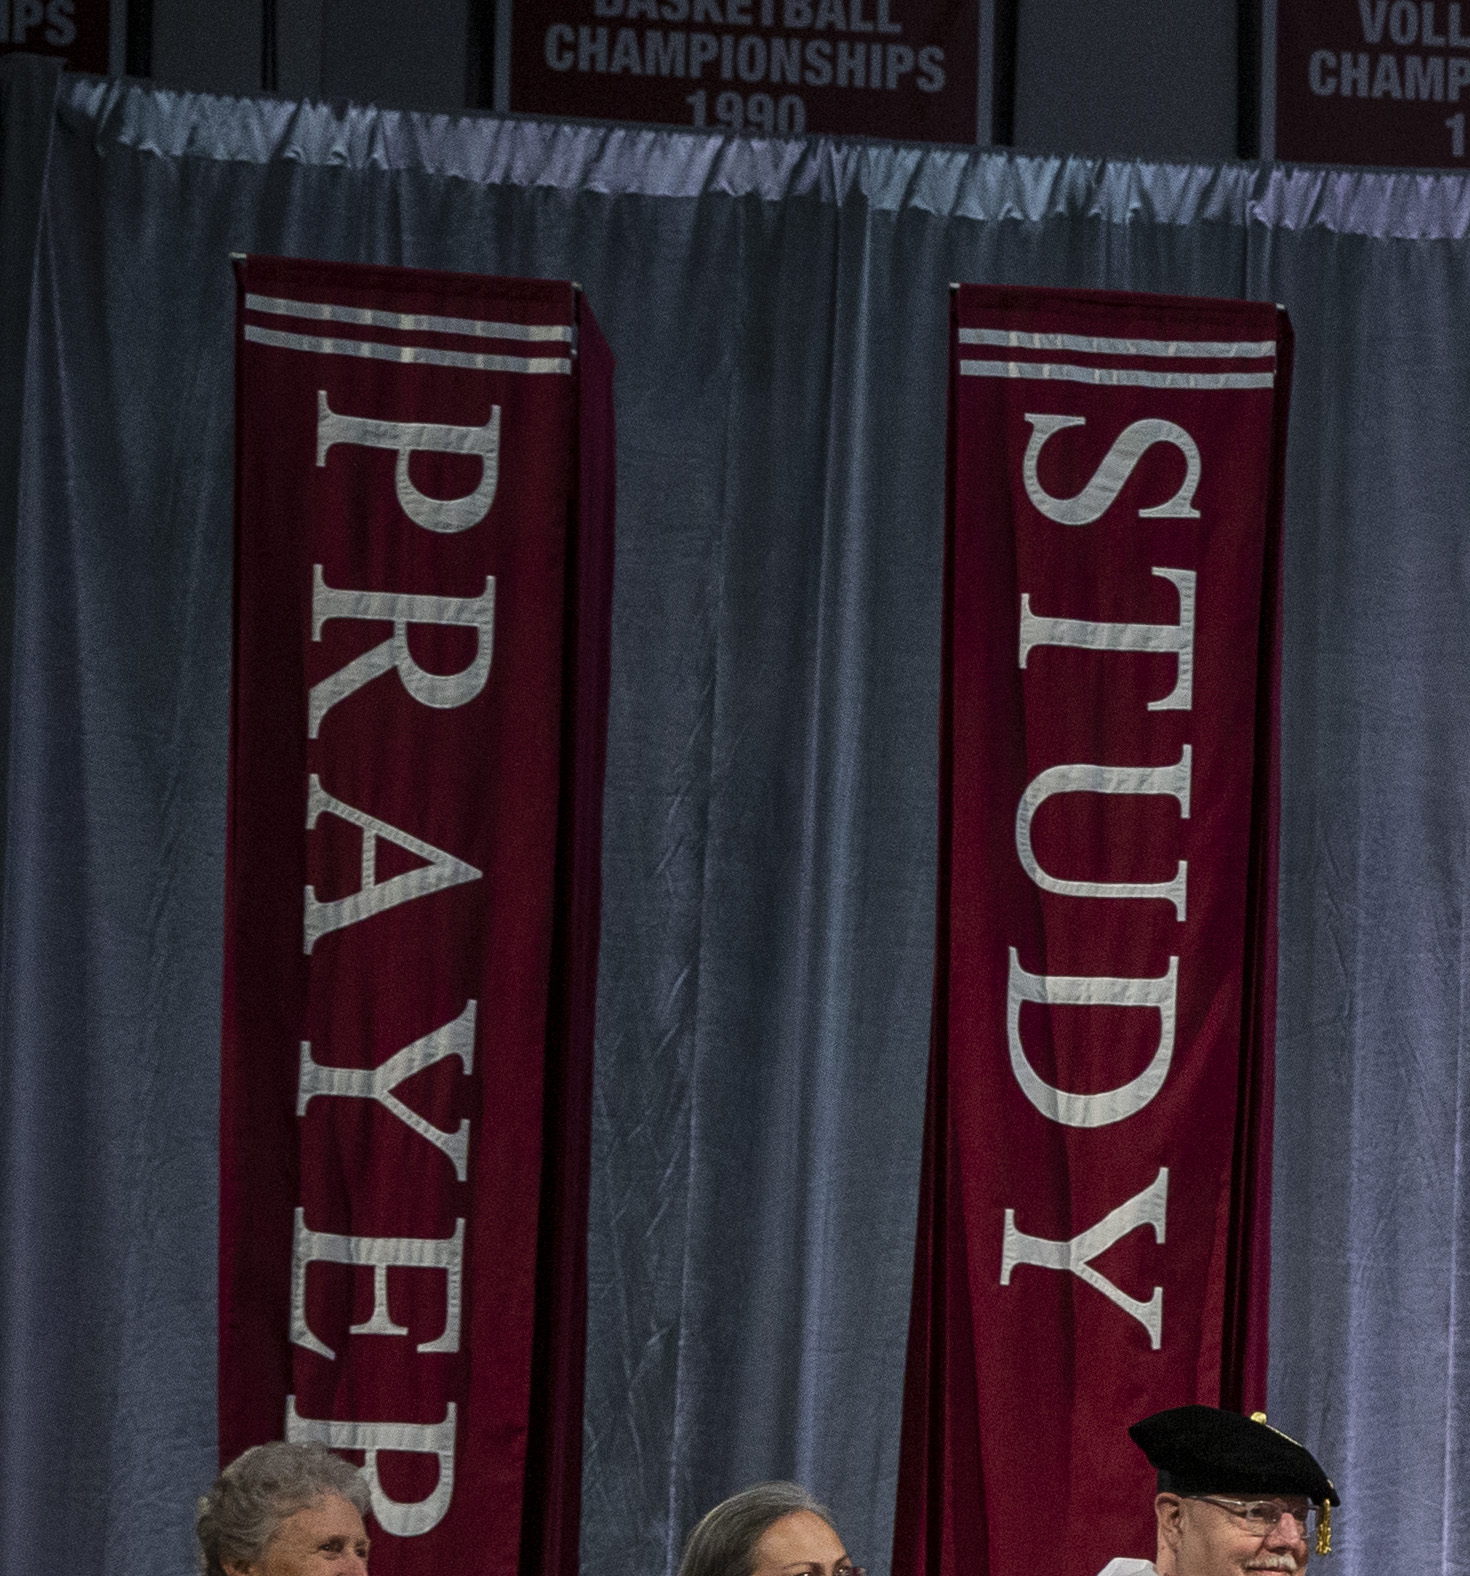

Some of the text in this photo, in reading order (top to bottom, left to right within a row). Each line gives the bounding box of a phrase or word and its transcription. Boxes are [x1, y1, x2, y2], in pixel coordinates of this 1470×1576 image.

[544, 23, 947, 93] CHAMPIONSHIPS
[687, 90, 808, 134] 1990
[999, 412, 1202, 1351] STUDY
